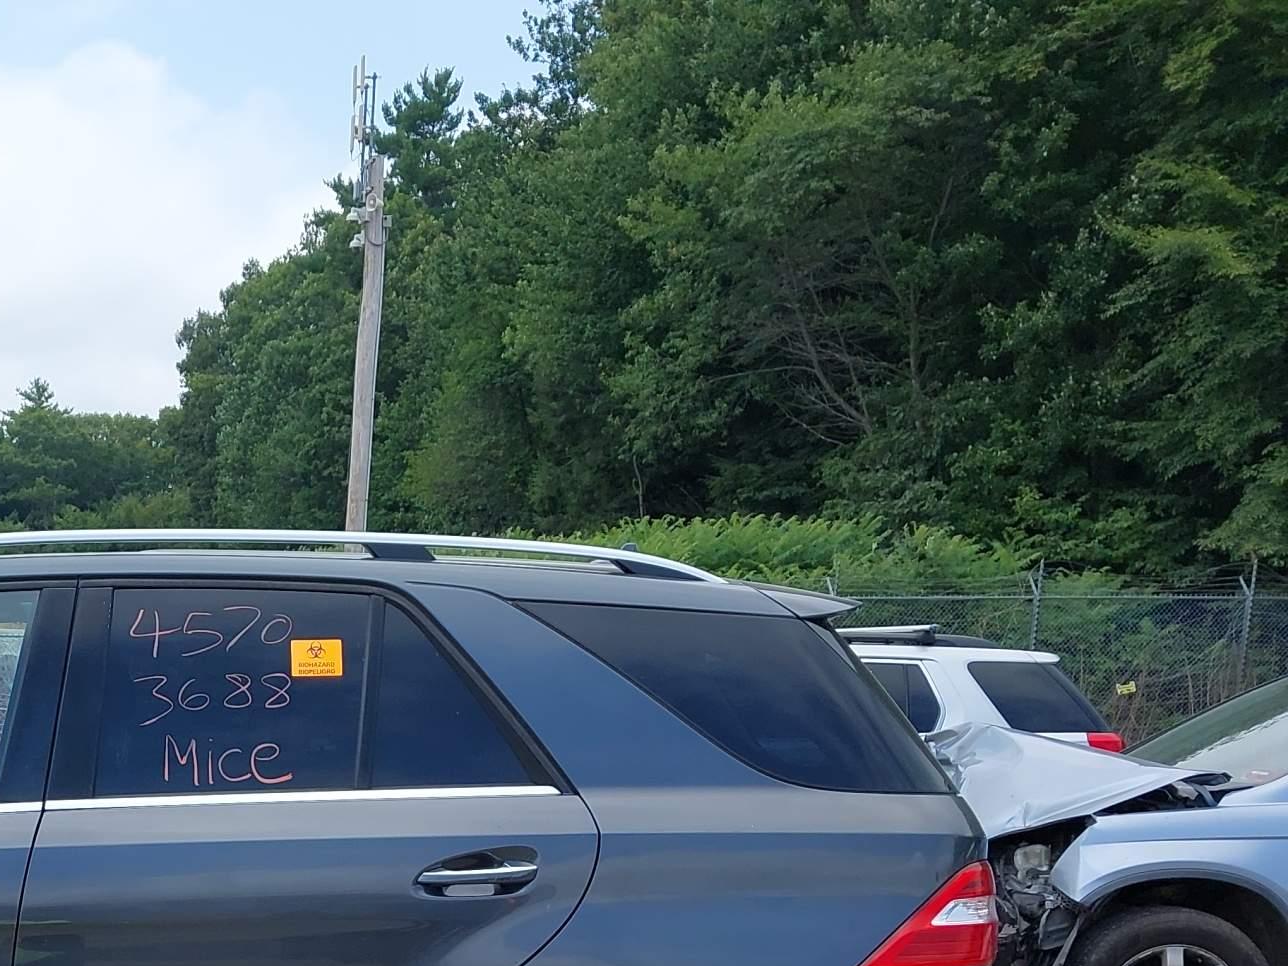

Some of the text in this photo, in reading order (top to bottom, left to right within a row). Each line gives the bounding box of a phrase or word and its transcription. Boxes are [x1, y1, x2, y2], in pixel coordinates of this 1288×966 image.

[130, 606, 292, 658] 4570
[134, 673, 292, 726] 3688
[164, 735, 293, 786] Mice
